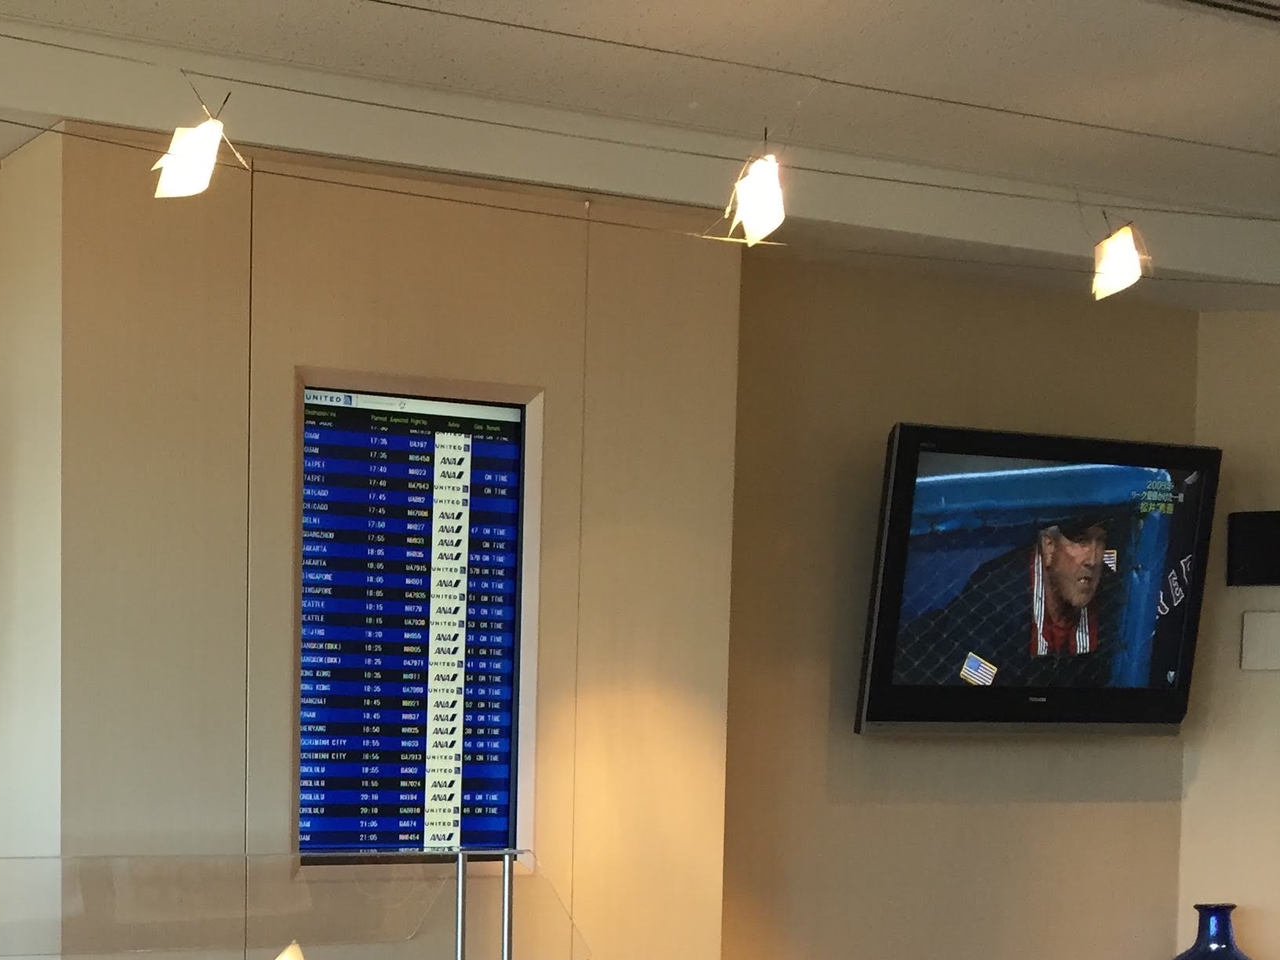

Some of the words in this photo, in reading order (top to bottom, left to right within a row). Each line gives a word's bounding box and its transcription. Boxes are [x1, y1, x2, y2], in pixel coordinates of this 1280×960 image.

[305, 393, 342, 403] UNITED
[435, 443, 462, 451] UNITED
[433, 498, 460, 506] UNITED
